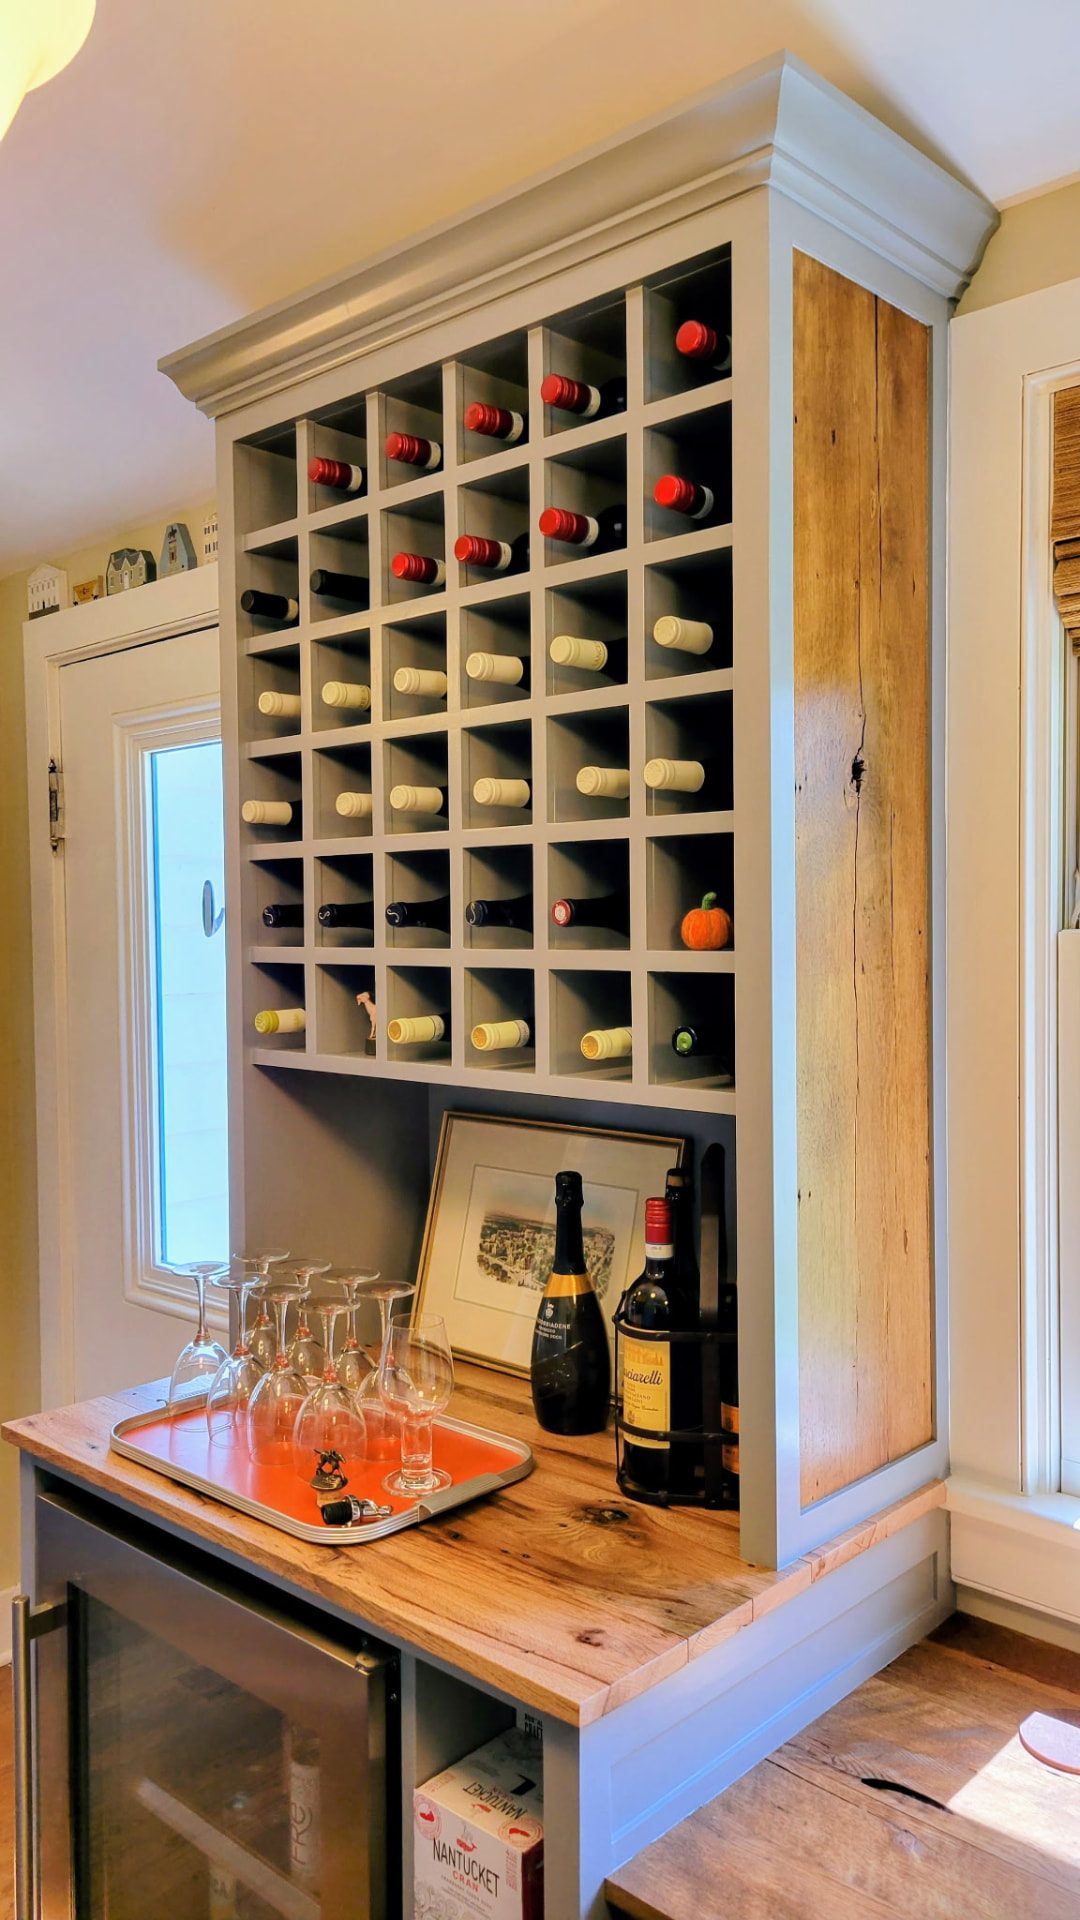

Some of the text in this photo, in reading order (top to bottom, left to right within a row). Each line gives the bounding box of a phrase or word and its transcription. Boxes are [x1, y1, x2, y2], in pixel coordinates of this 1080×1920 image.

[462, 1781, 529, 1821] NANTUCKET
[432, 1836, 500, 1898] NANTUCKET
[452, 1869, 480, 1893] CRAN
